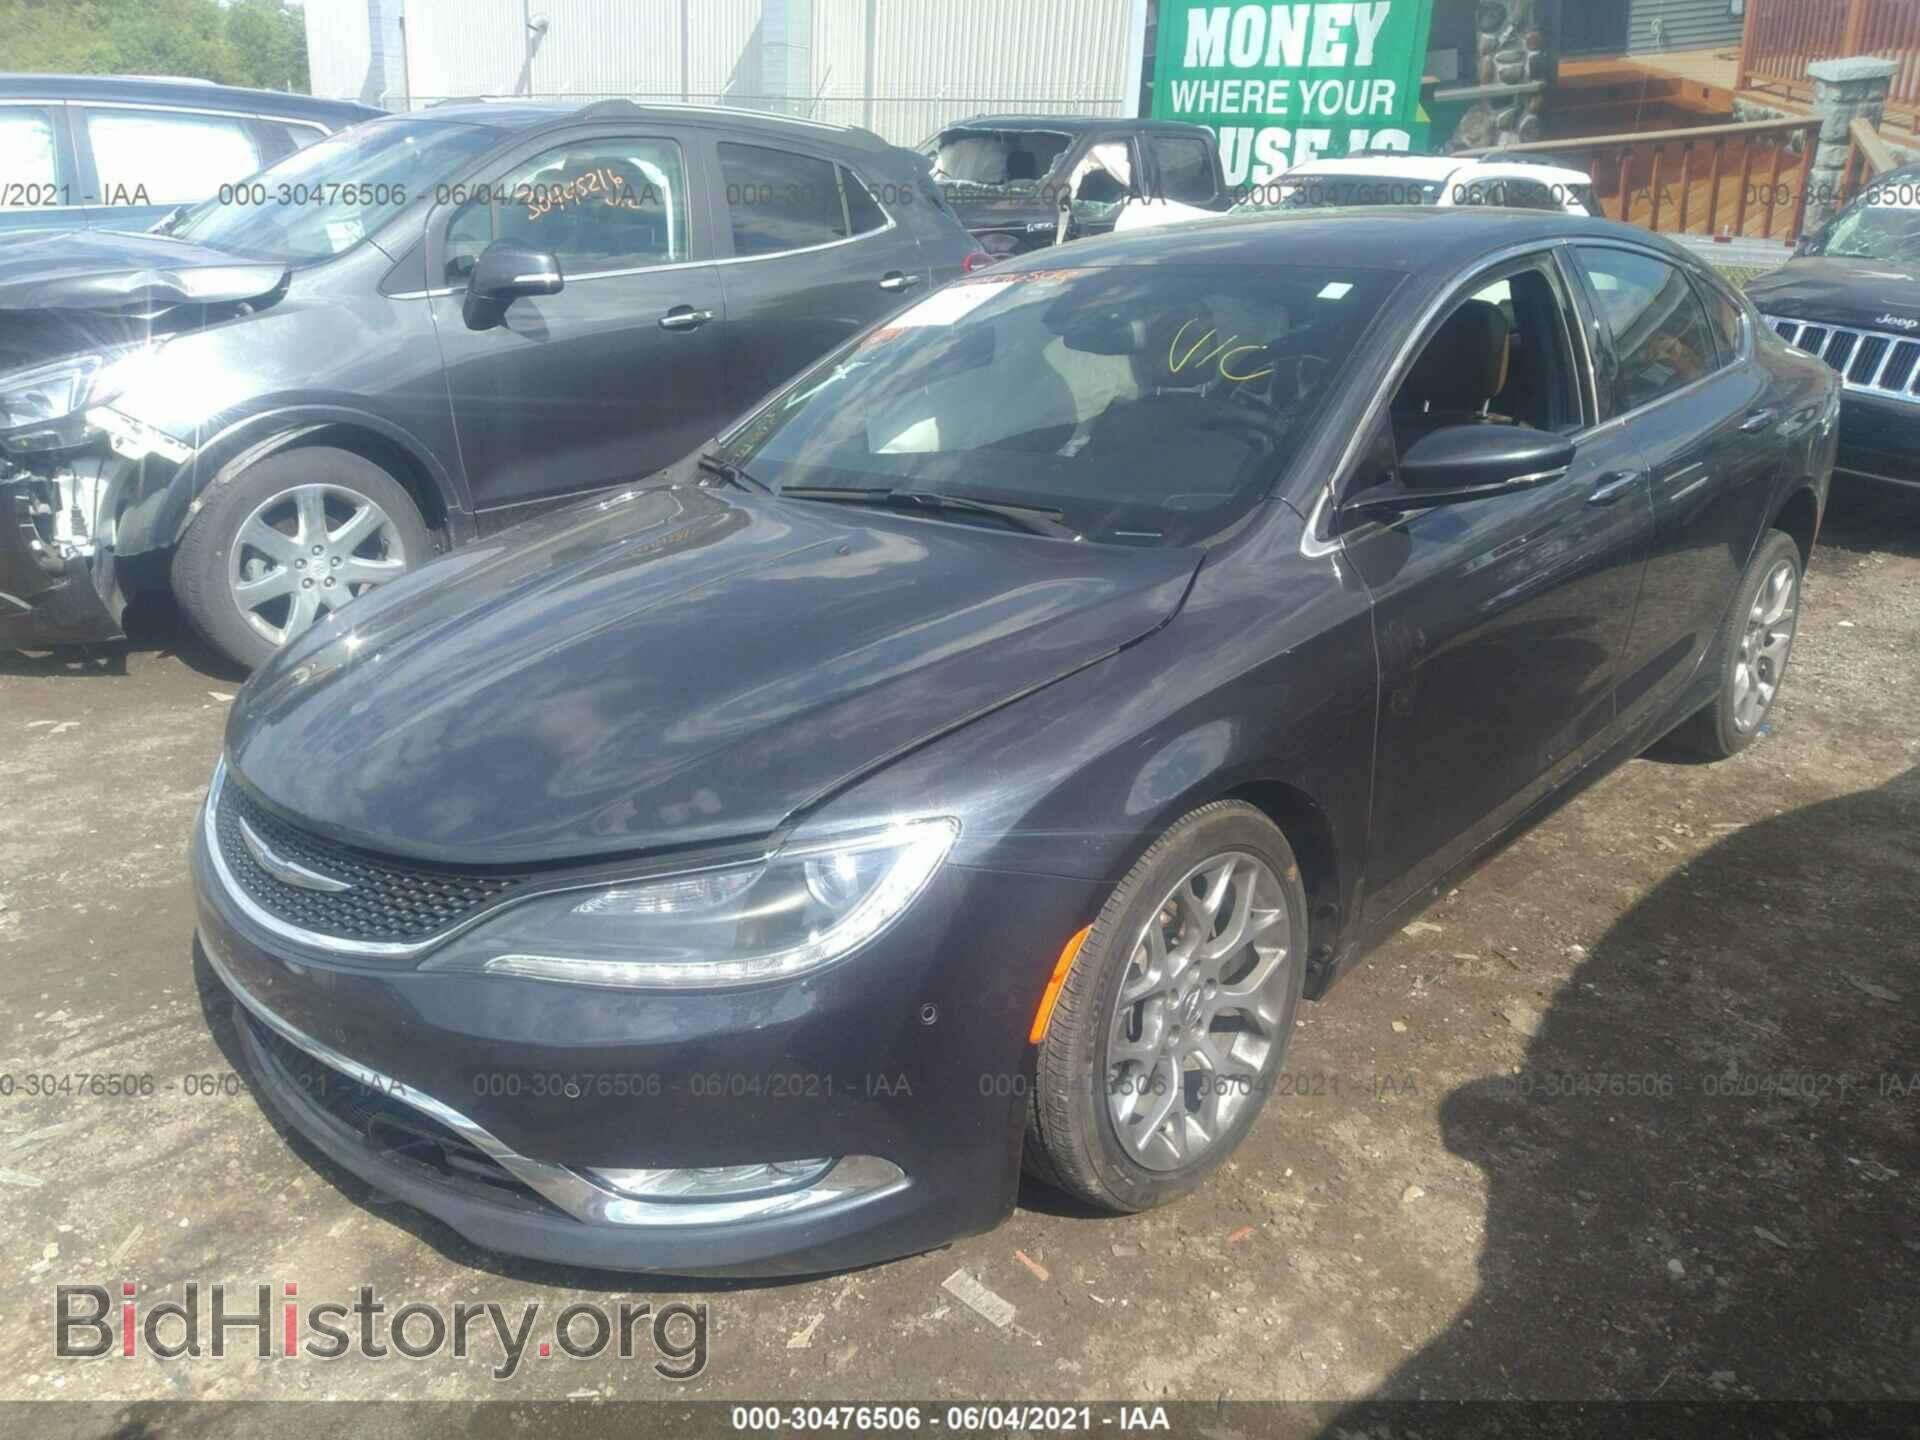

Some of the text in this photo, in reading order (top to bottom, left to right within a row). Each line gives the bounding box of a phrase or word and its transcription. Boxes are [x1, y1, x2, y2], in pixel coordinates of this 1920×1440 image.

[1183, 1, 1391, 68] MONEY
[1171, 79, 1396, 116] WHERE YOUR
[1875, 313, 1918, 330] Jeep
